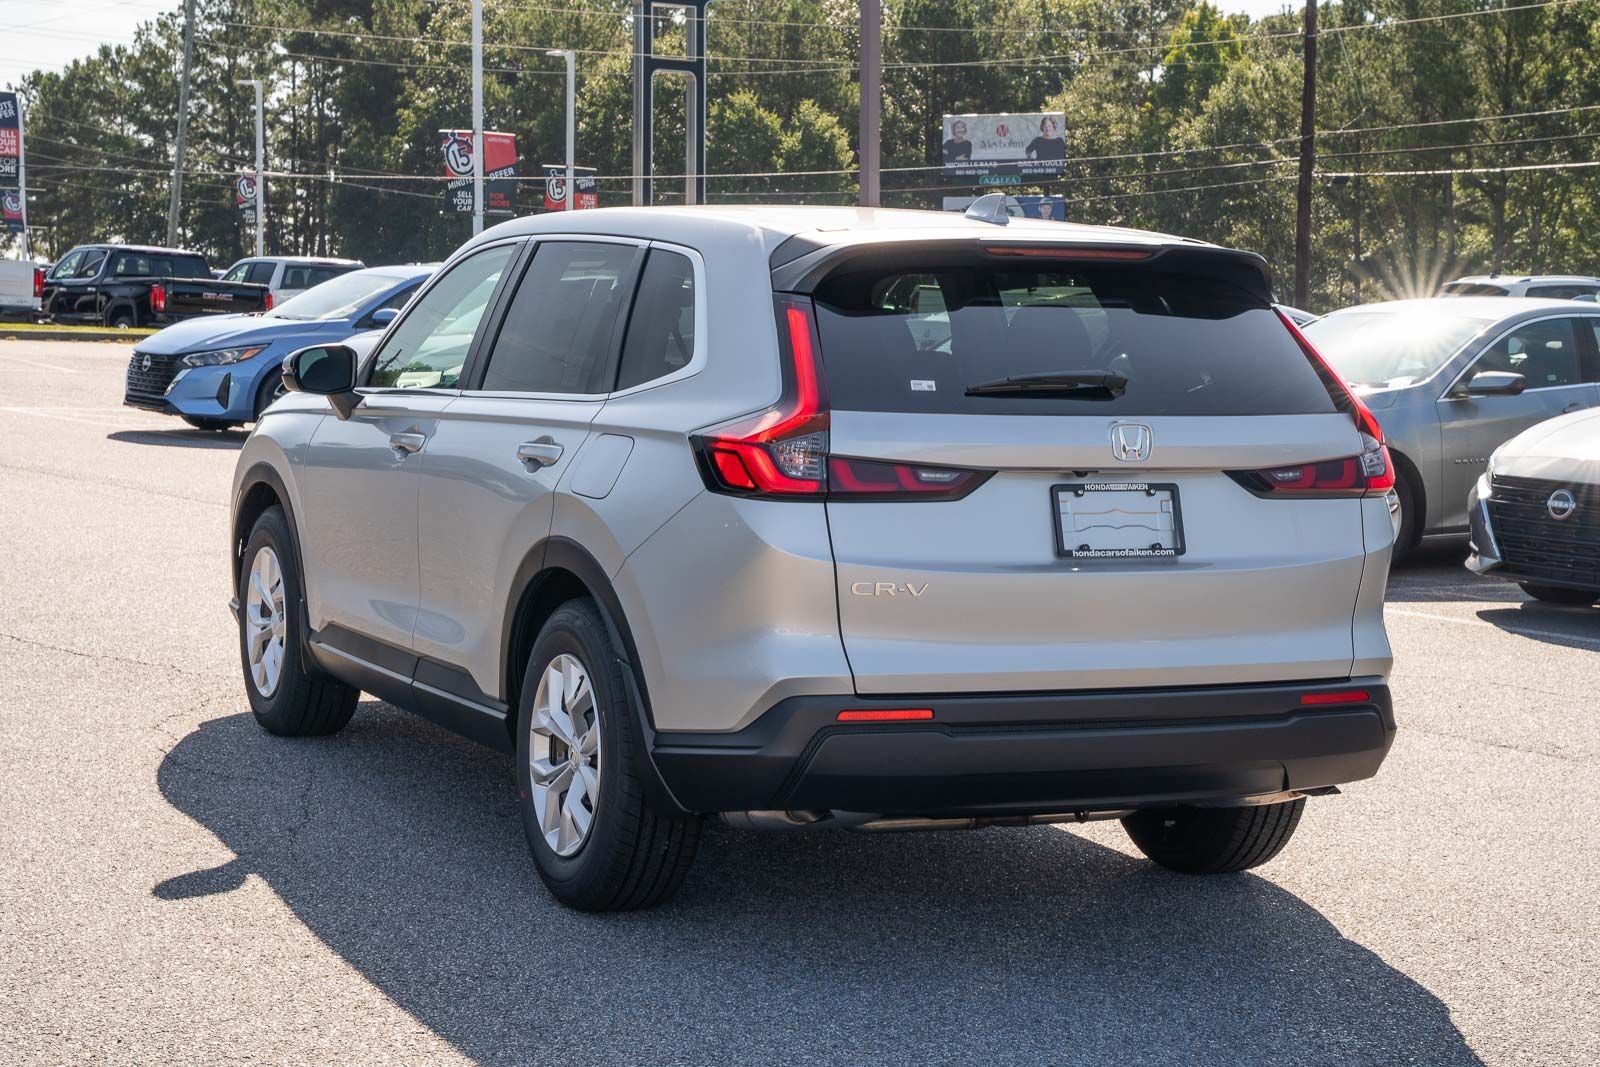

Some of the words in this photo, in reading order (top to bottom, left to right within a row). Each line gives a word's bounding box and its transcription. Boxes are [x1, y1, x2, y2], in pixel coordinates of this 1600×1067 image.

[489, 167, 515, 181] OFFER
[457, 191, 473, 199] SELL
[453, 198, 473, 206] YOUR
[1084, 483, 1111, 491] HONDA
[1072, 549, 1175, 557] hondacarsofaiken.com
[851, 582, 929, 596] CR-V
